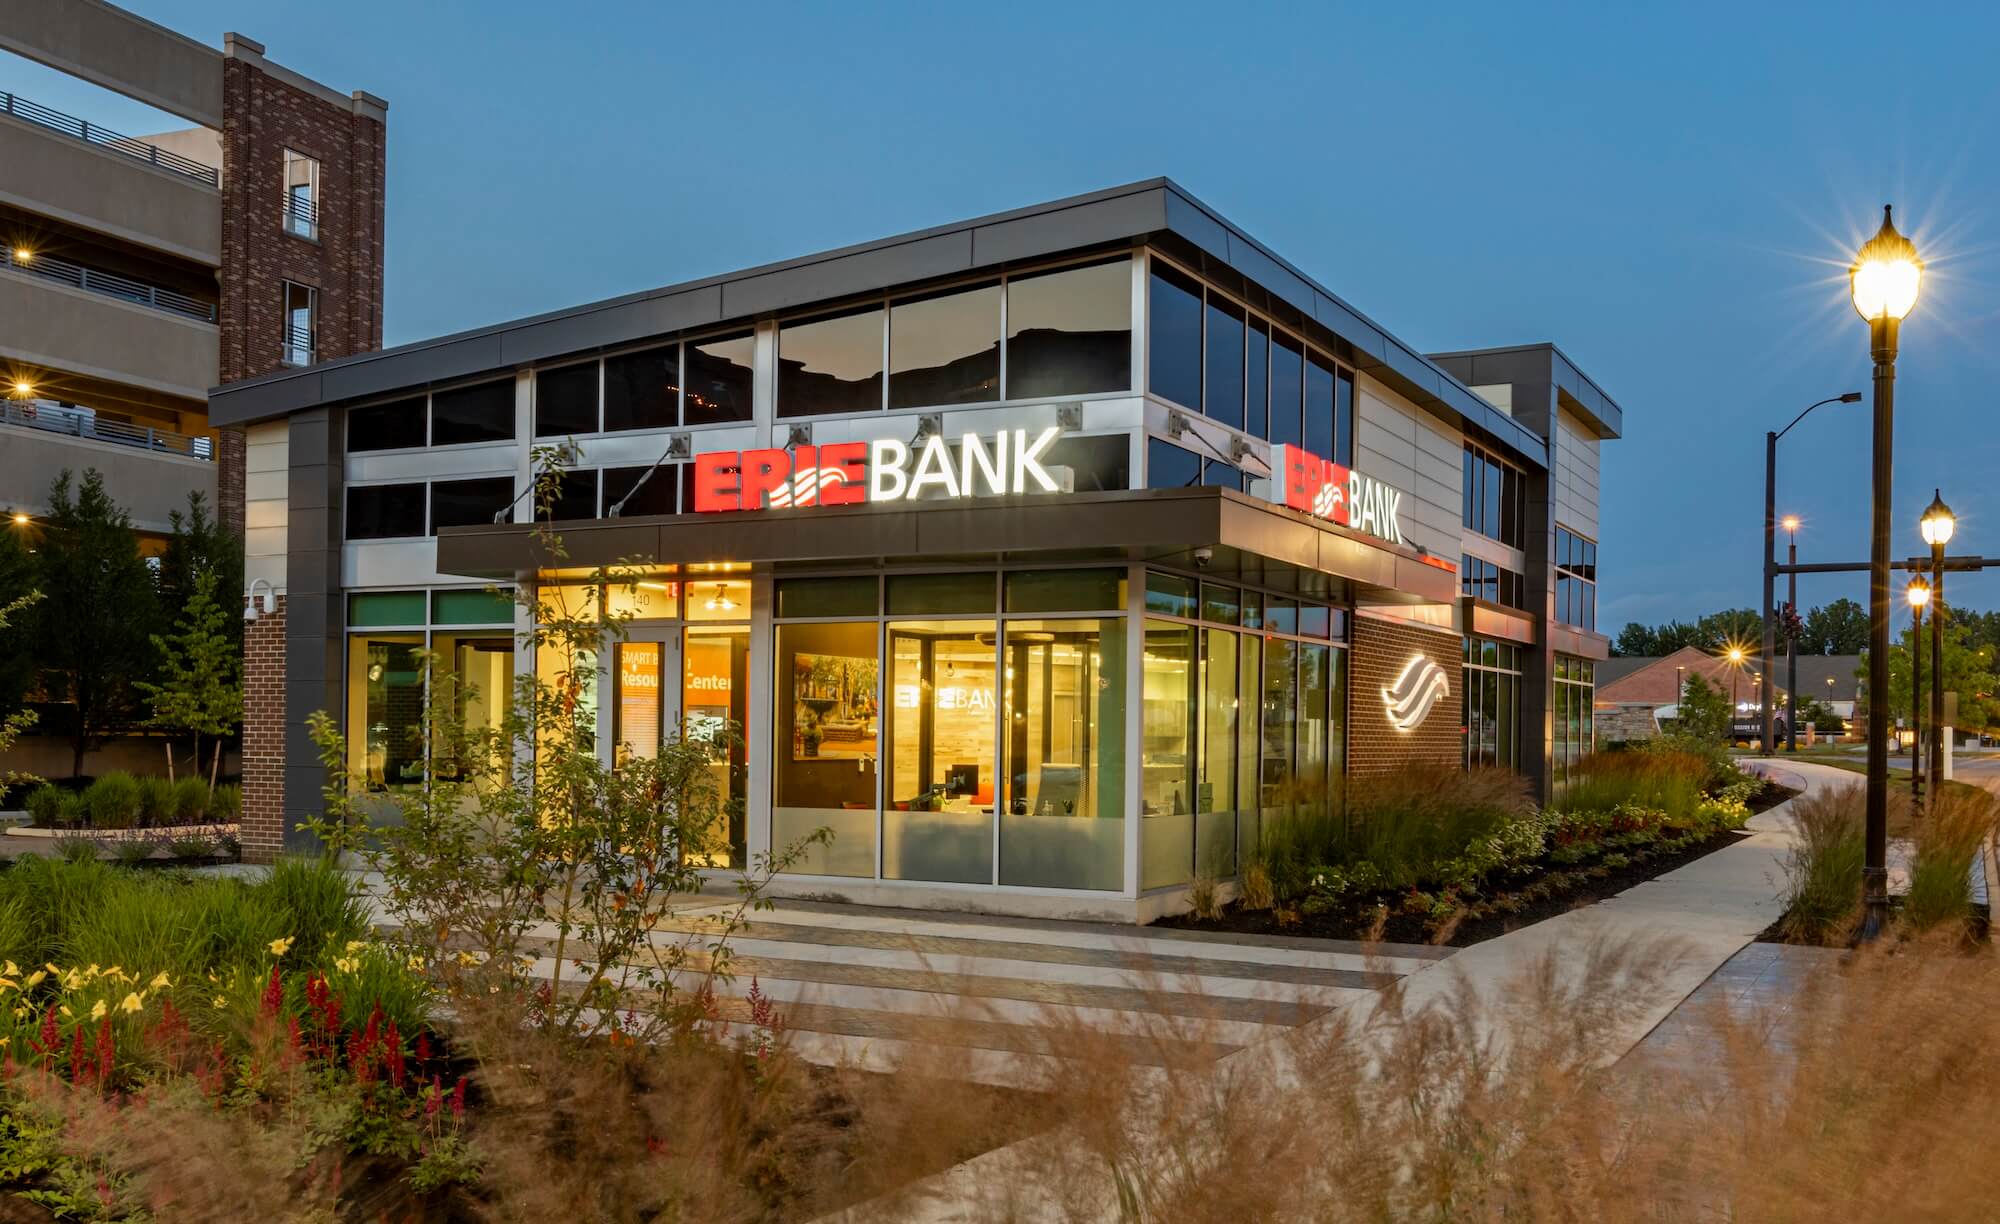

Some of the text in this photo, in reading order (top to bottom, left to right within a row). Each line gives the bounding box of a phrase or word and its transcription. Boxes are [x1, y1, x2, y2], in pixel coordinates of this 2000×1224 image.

[633, 594, 650, 607] 140
[622, 651, 651, 664] SMART
[622, 670, 658, 687] Resou
